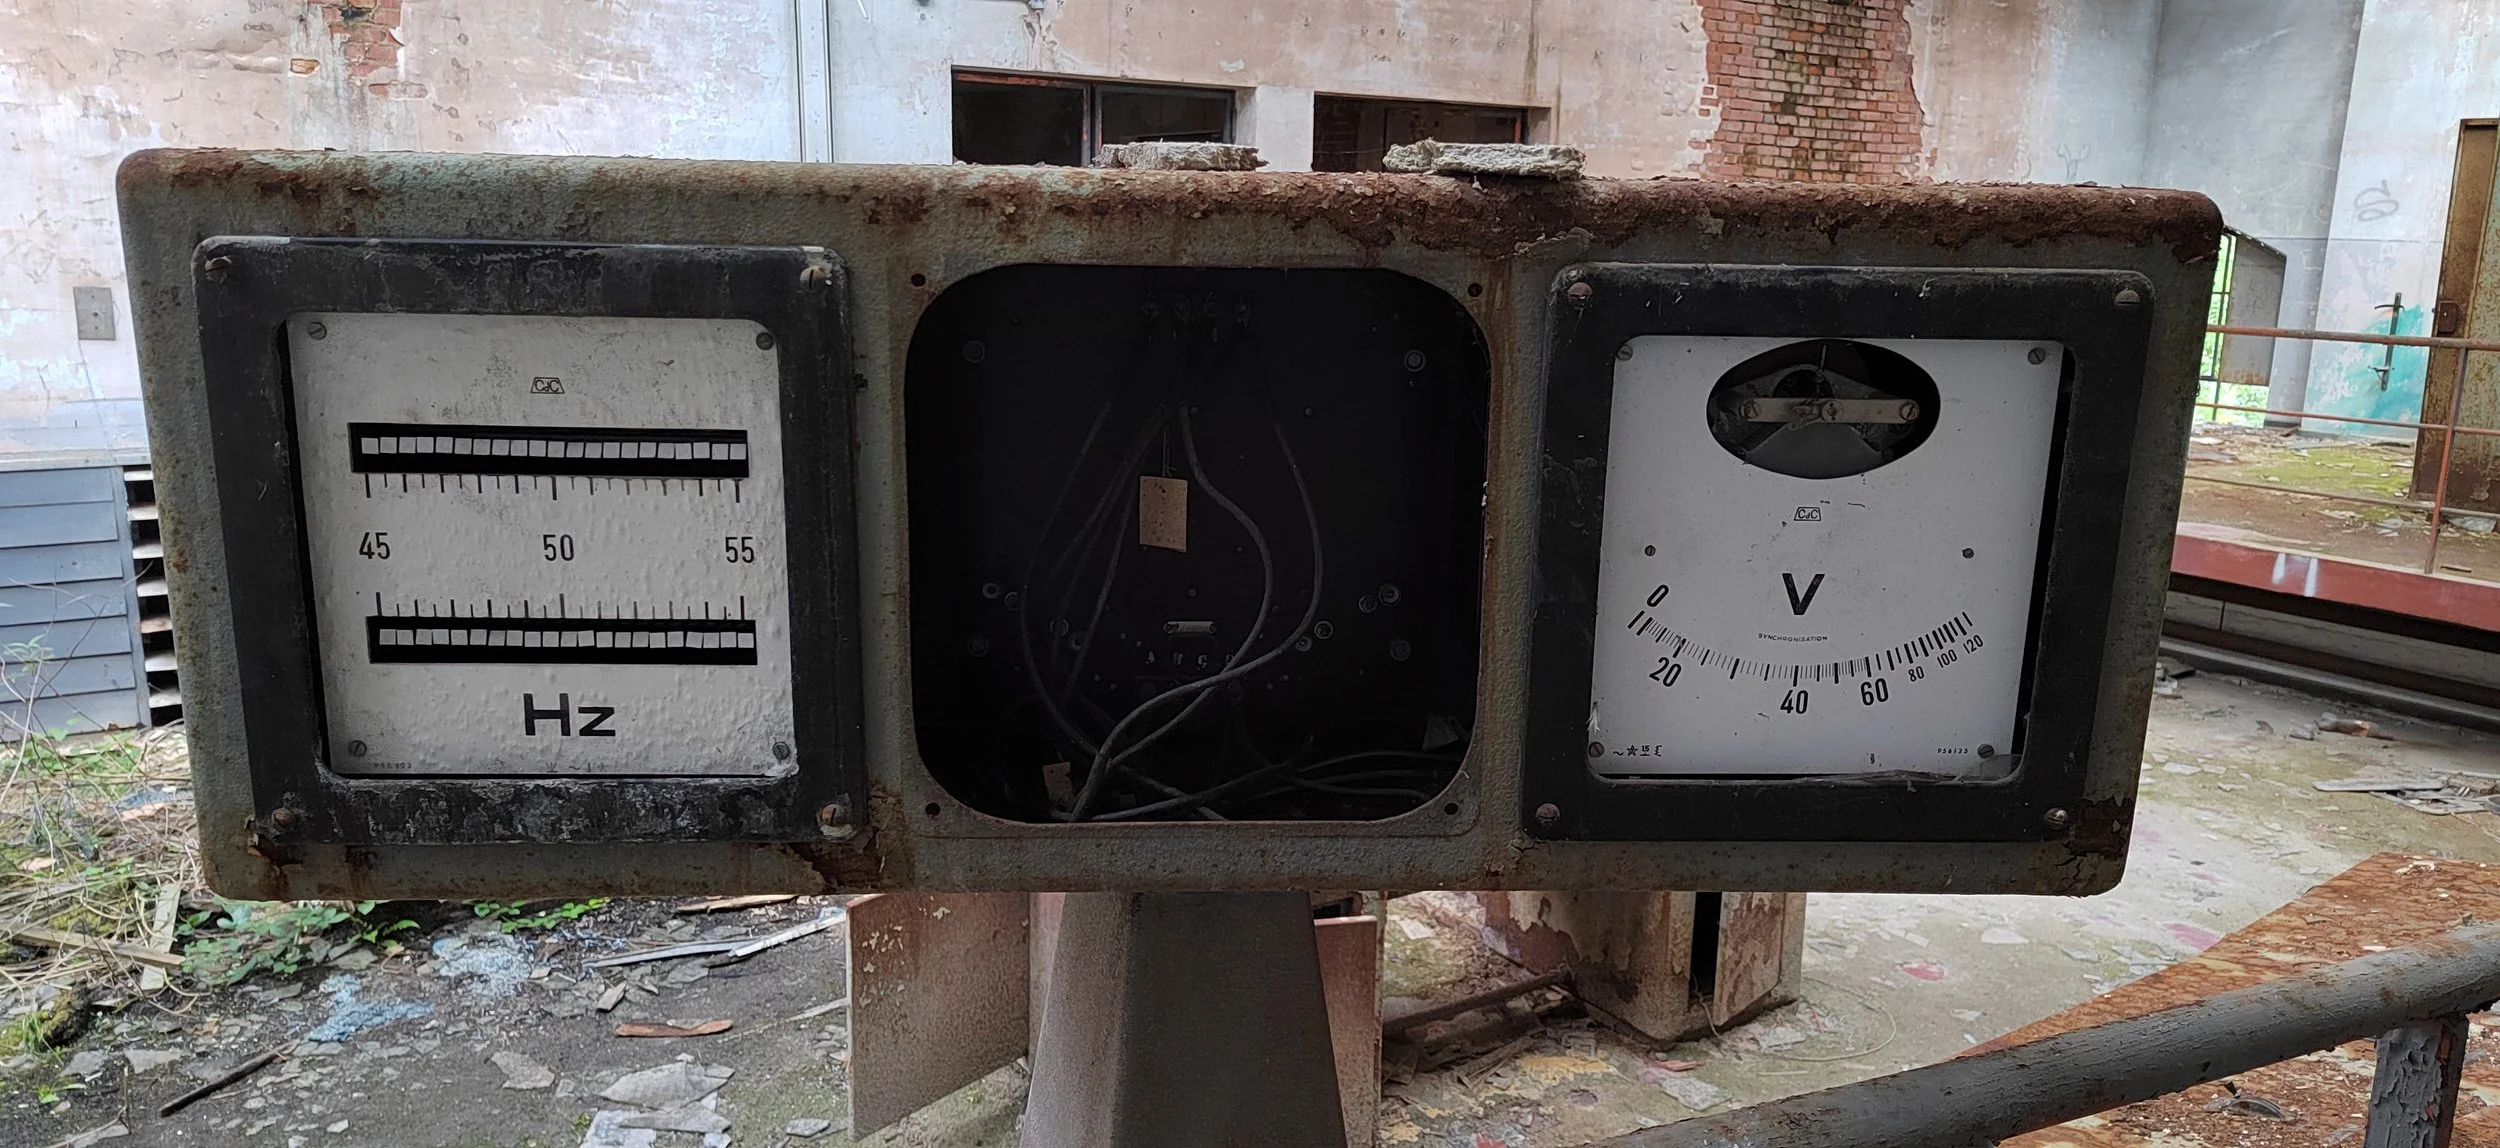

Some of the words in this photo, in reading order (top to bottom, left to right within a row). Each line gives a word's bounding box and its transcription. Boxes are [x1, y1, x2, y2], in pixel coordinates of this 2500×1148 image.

[359, 532, 391, 561] 45
[543, 534, 575, 562] 50
[725, 536, 756, 564] 55
[1647, 584, 1669, 608] 0
[1782, 573, 1825, 616] V
[1758, 632, 1829, 643] SYNCHRONISATION
[1963, 634, 1984, 654] 120
[1937, 649, 1957, 669] 100
[1649, 656, 1682, 688] 20
[1908, 666, 1925, 682] 80
[1780, 690, 1809, 715] 40
[1861, 678, 1889, 706] 60
[523, 693, 616, 737] Hz
